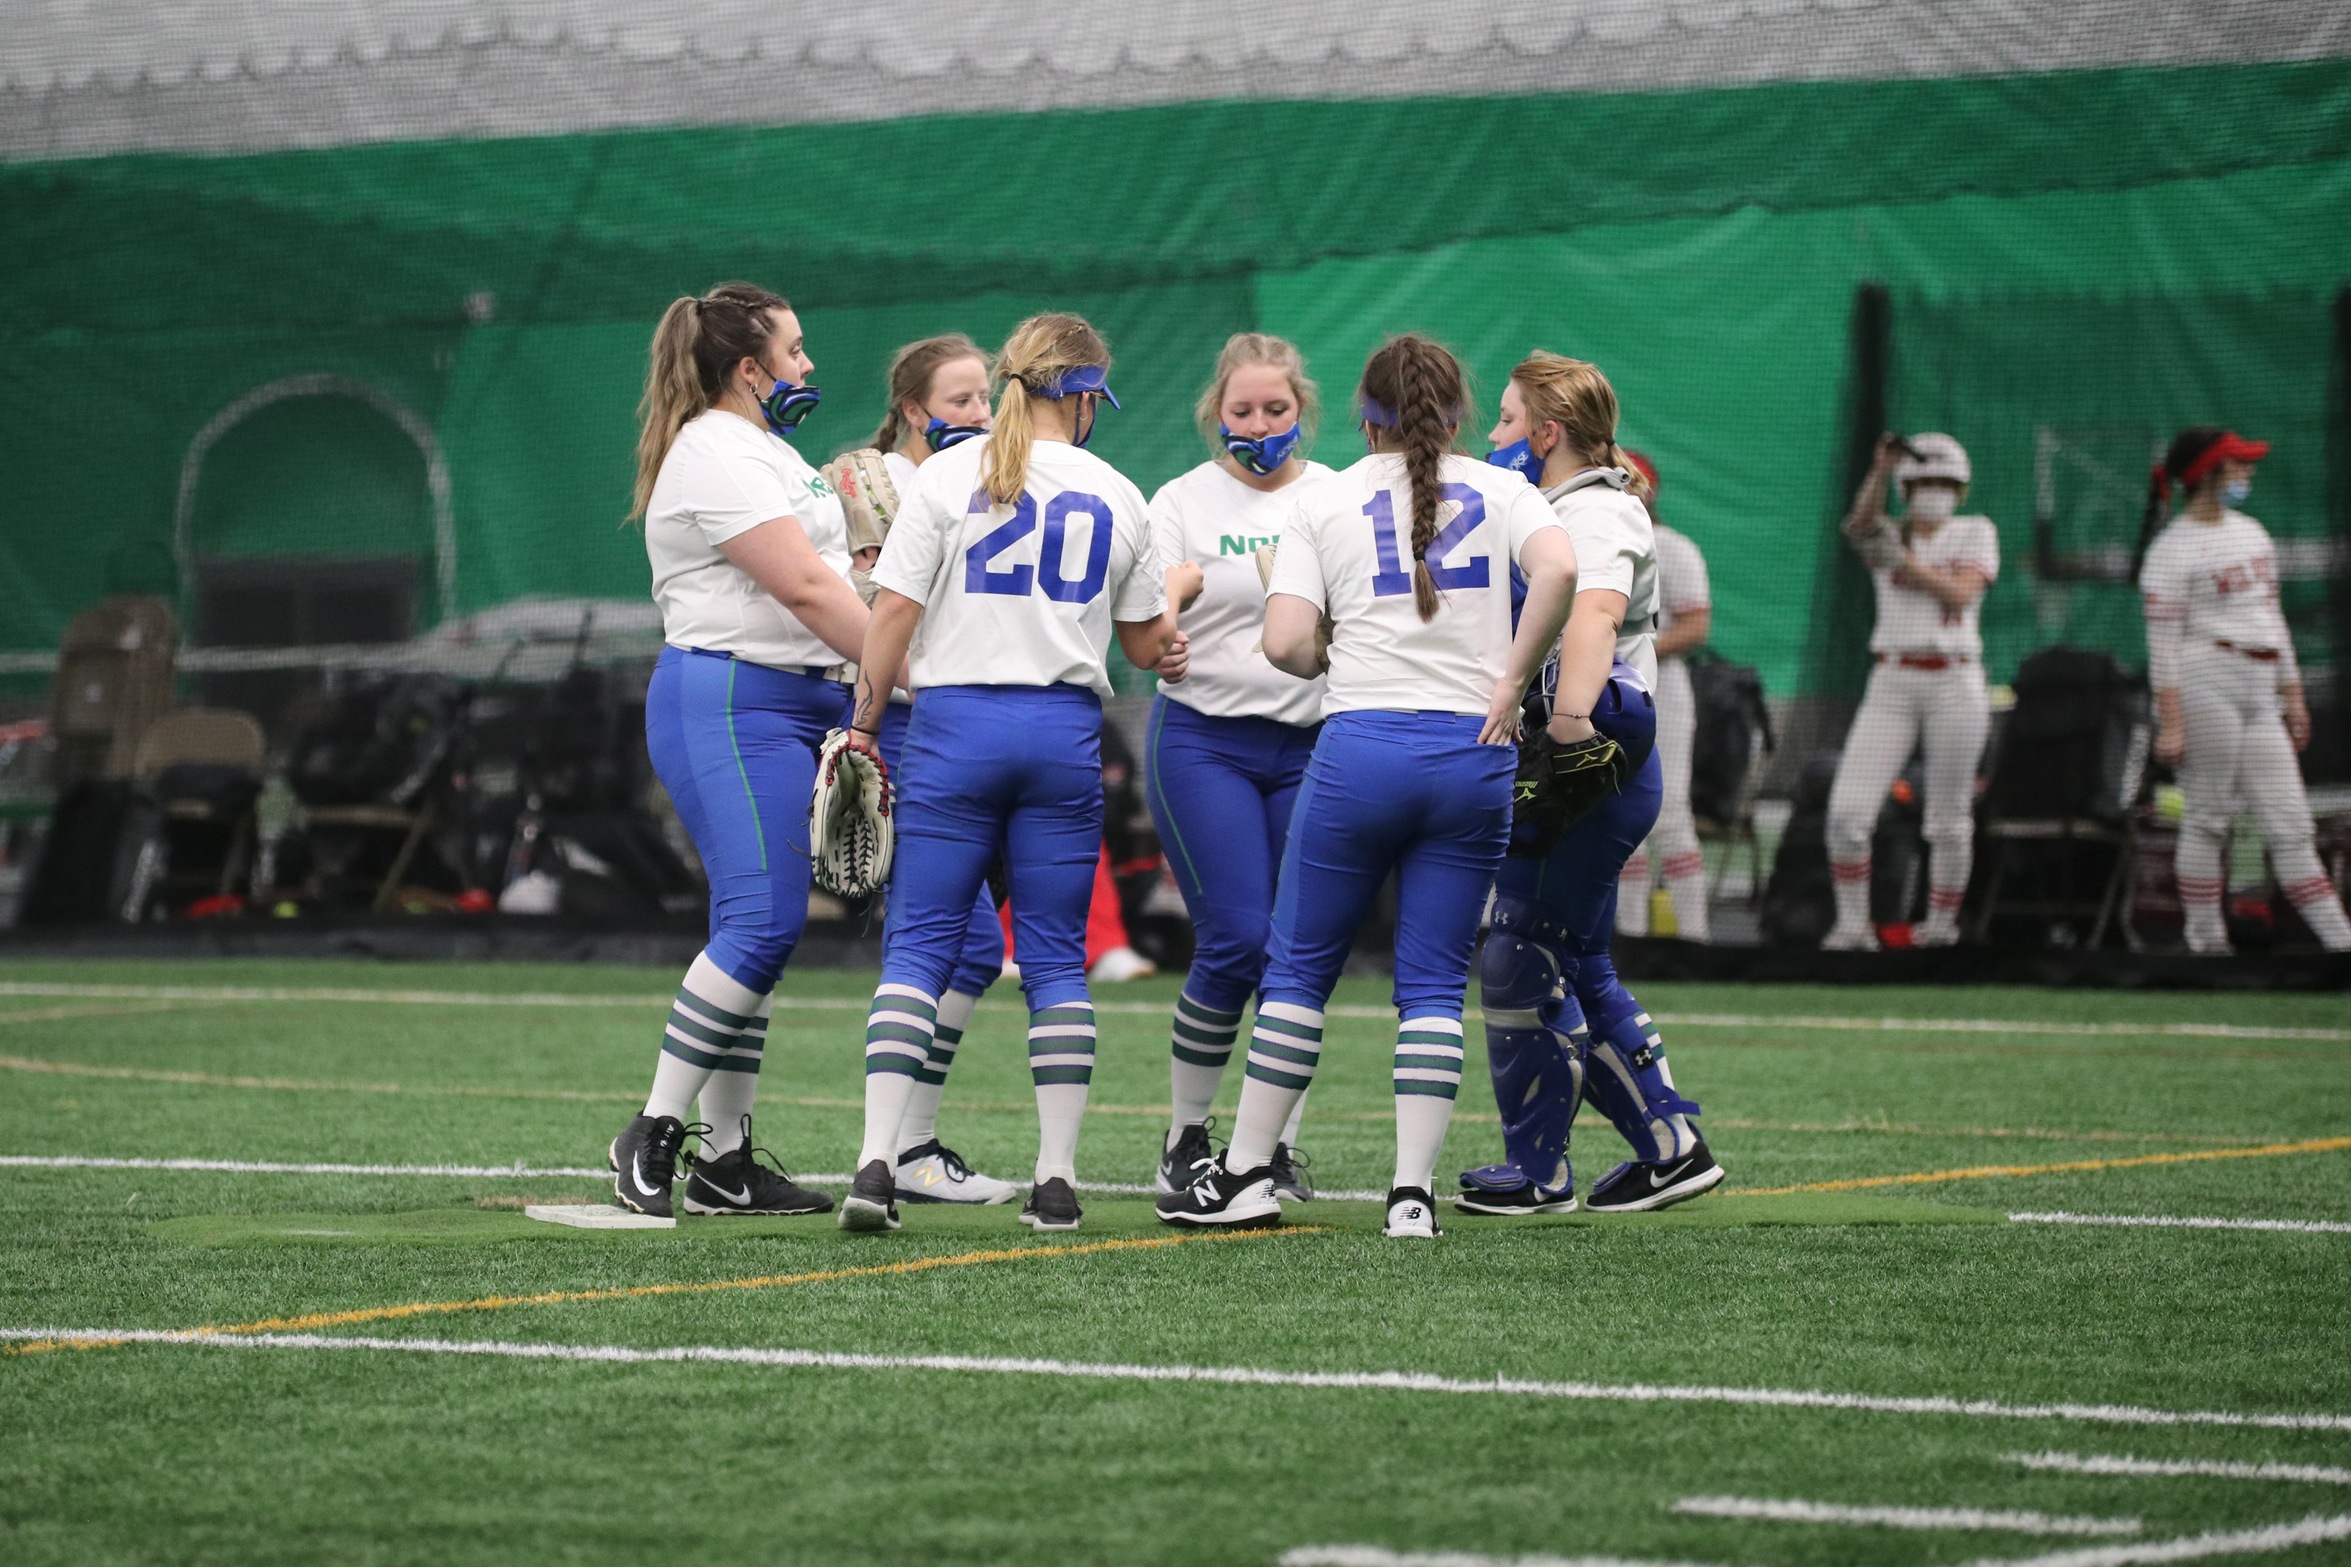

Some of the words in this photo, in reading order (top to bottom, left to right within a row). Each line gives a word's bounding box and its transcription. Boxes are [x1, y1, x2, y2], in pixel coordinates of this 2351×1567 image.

[1507, 450, 1530, 471] ORSE
[965, 486, 1114, 604] 20
[1362, 482, 1490, 597] 12
[1193, 1179, 1222, 1208] N
